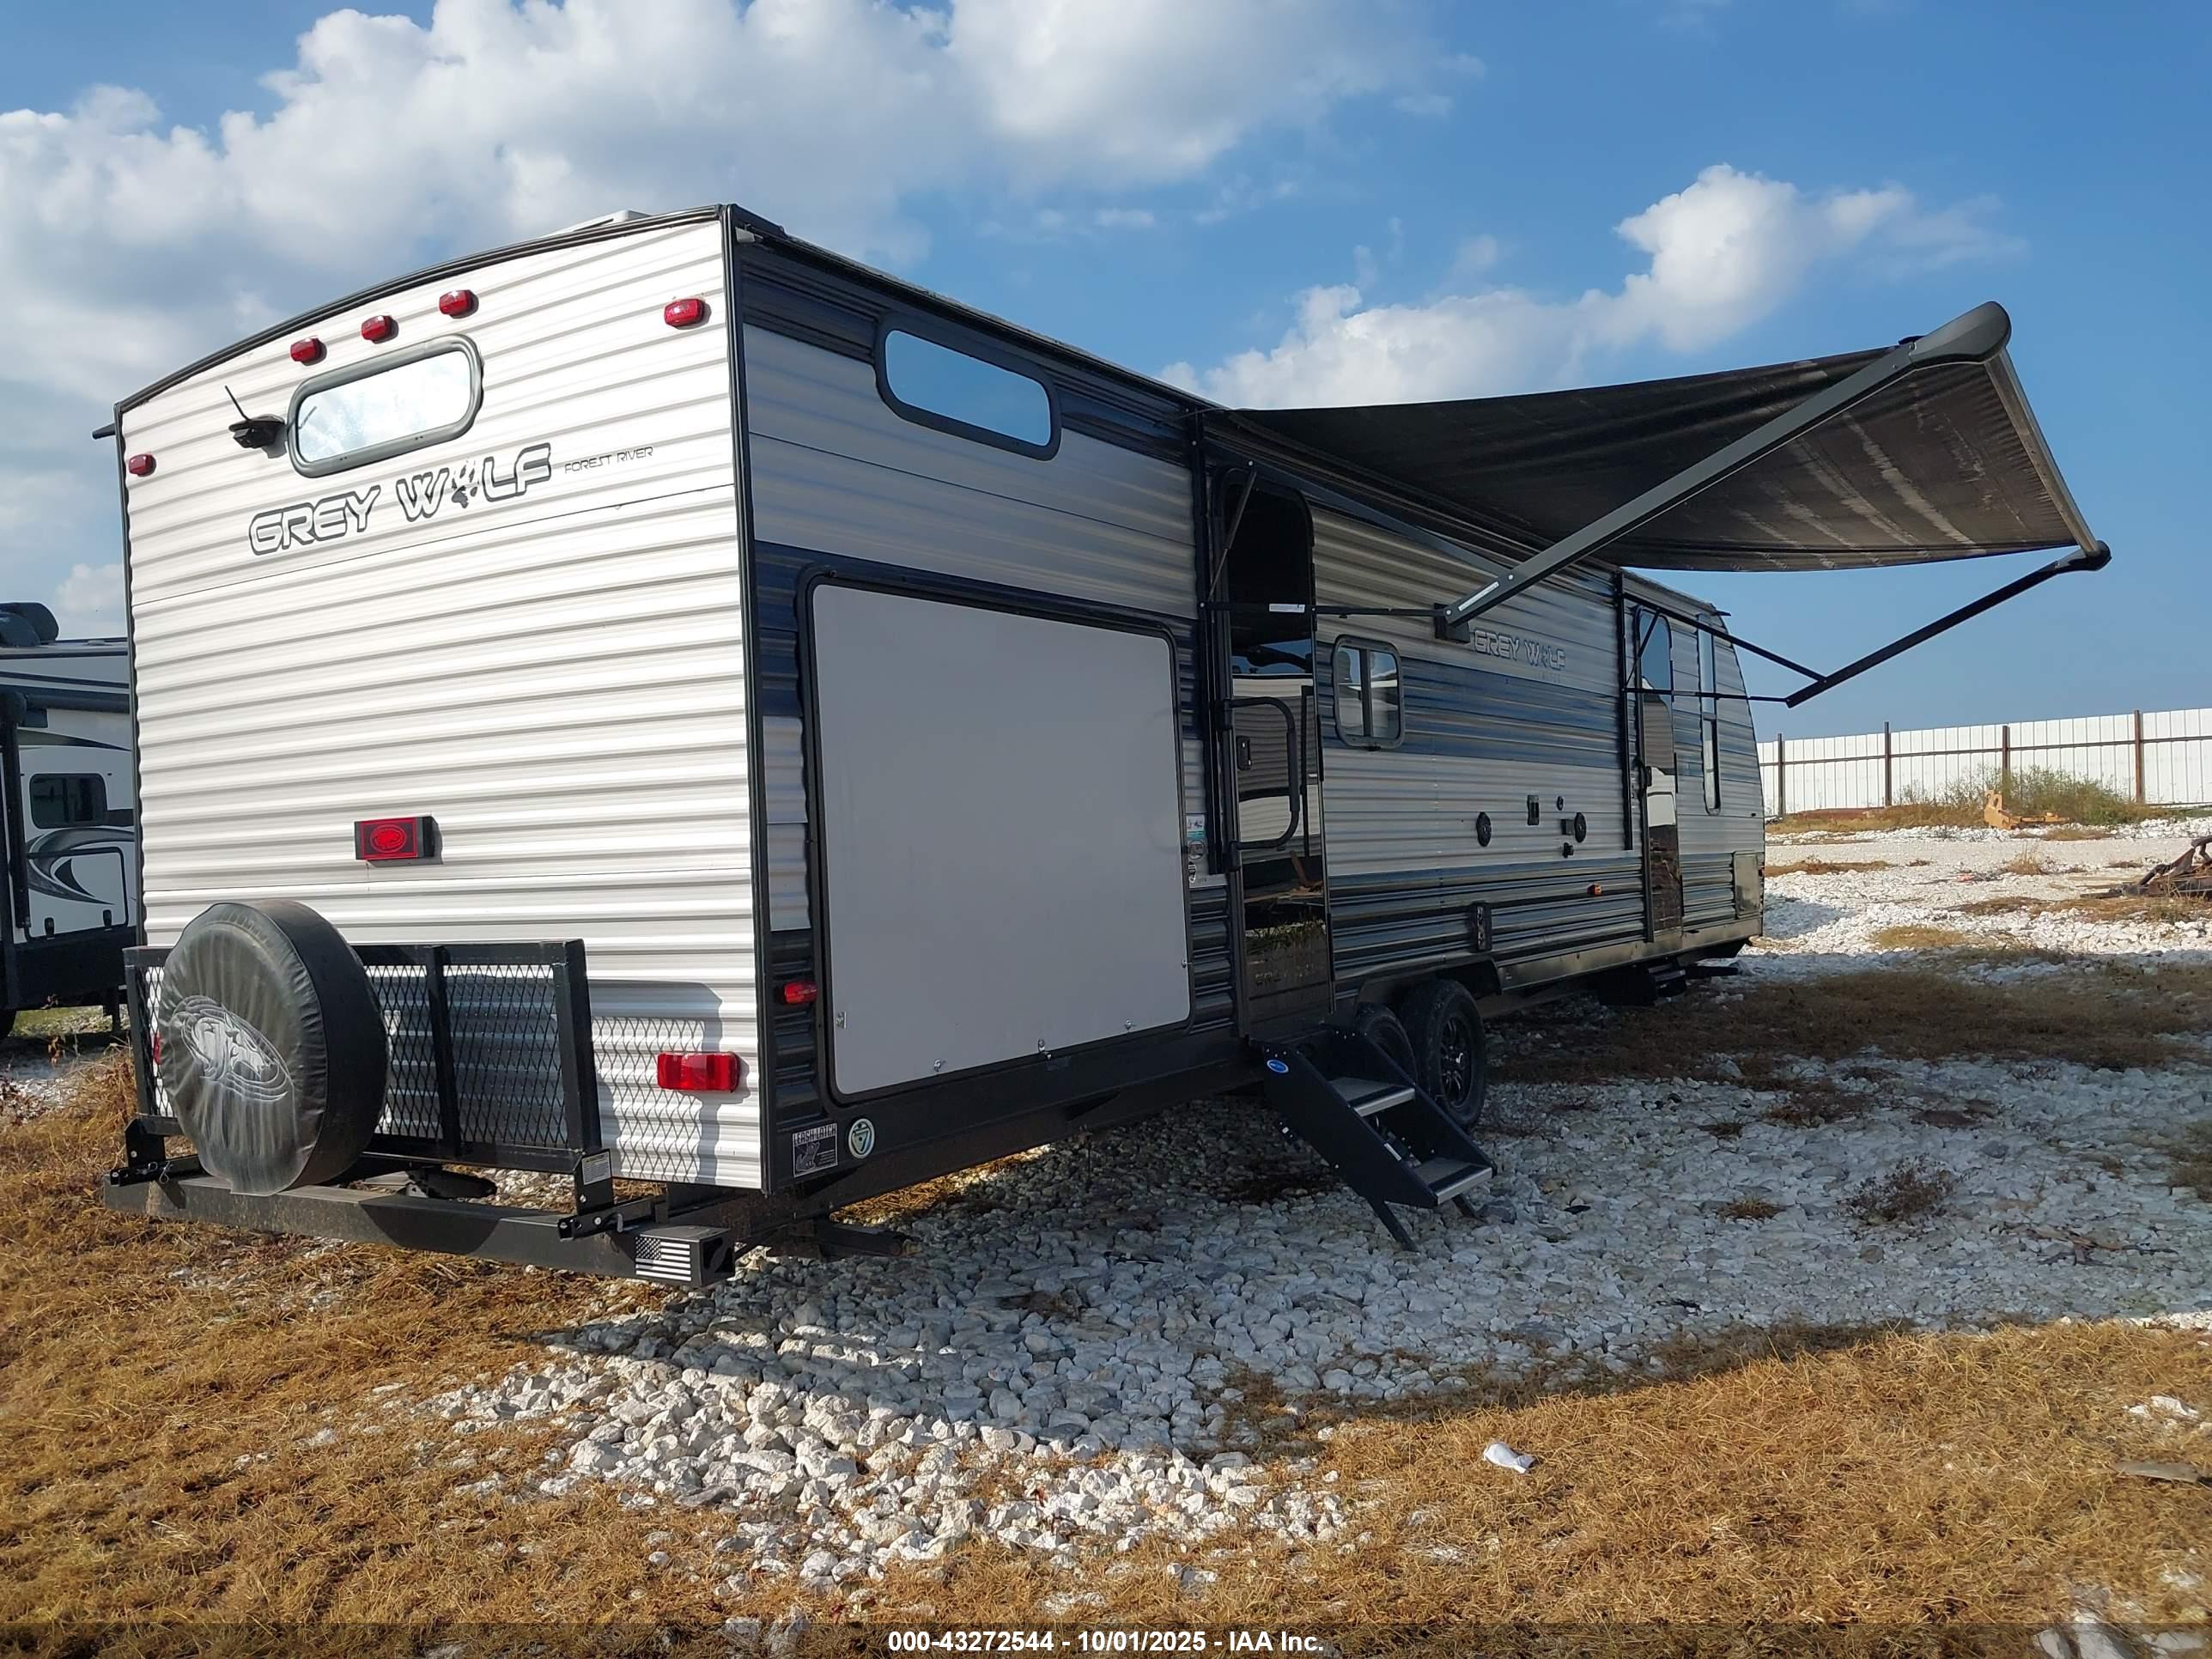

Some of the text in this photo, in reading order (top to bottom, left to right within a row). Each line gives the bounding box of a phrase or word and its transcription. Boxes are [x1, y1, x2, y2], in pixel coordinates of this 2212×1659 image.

[564, 447, 653, 474] FOREST RIVER
[249, 485, 381, 555] GREY
[1474, 629, 1519, 660] GREY
